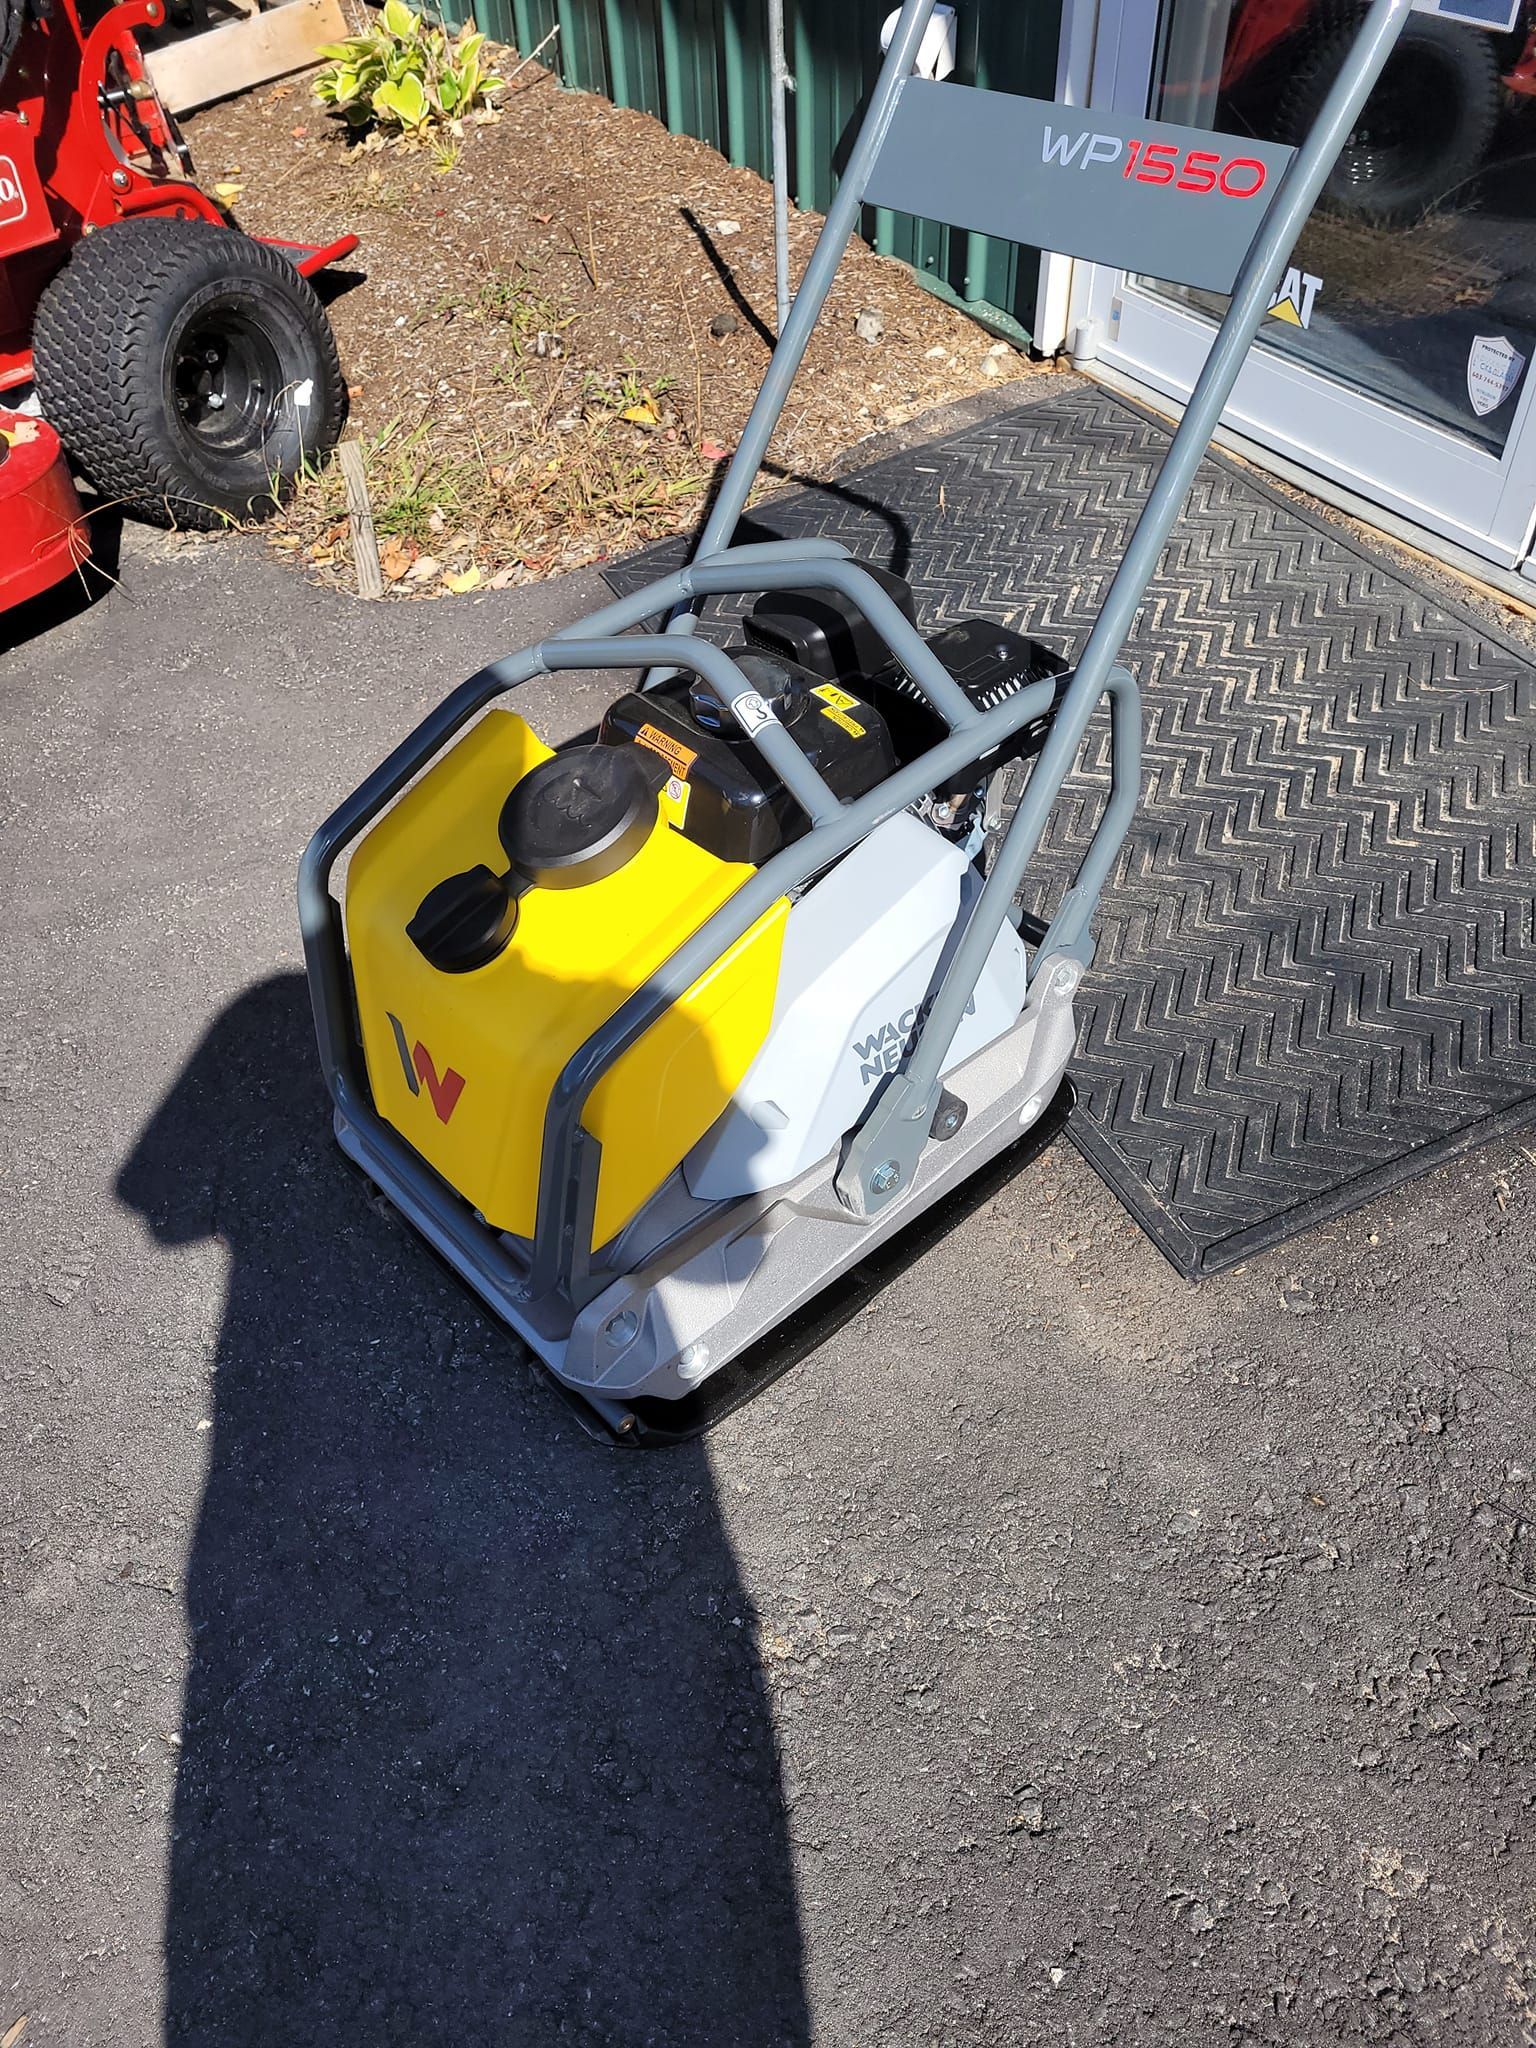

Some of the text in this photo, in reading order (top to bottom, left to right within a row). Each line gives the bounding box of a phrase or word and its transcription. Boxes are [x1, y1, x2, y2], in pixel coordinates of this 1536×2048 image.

[1042, 126, 1267, 198] WP1550
[1482, 344, 1508, 359] PROTECTED
[649, 731, 682, 755] WARNING
[853, 990, 939, 1060] WACK
